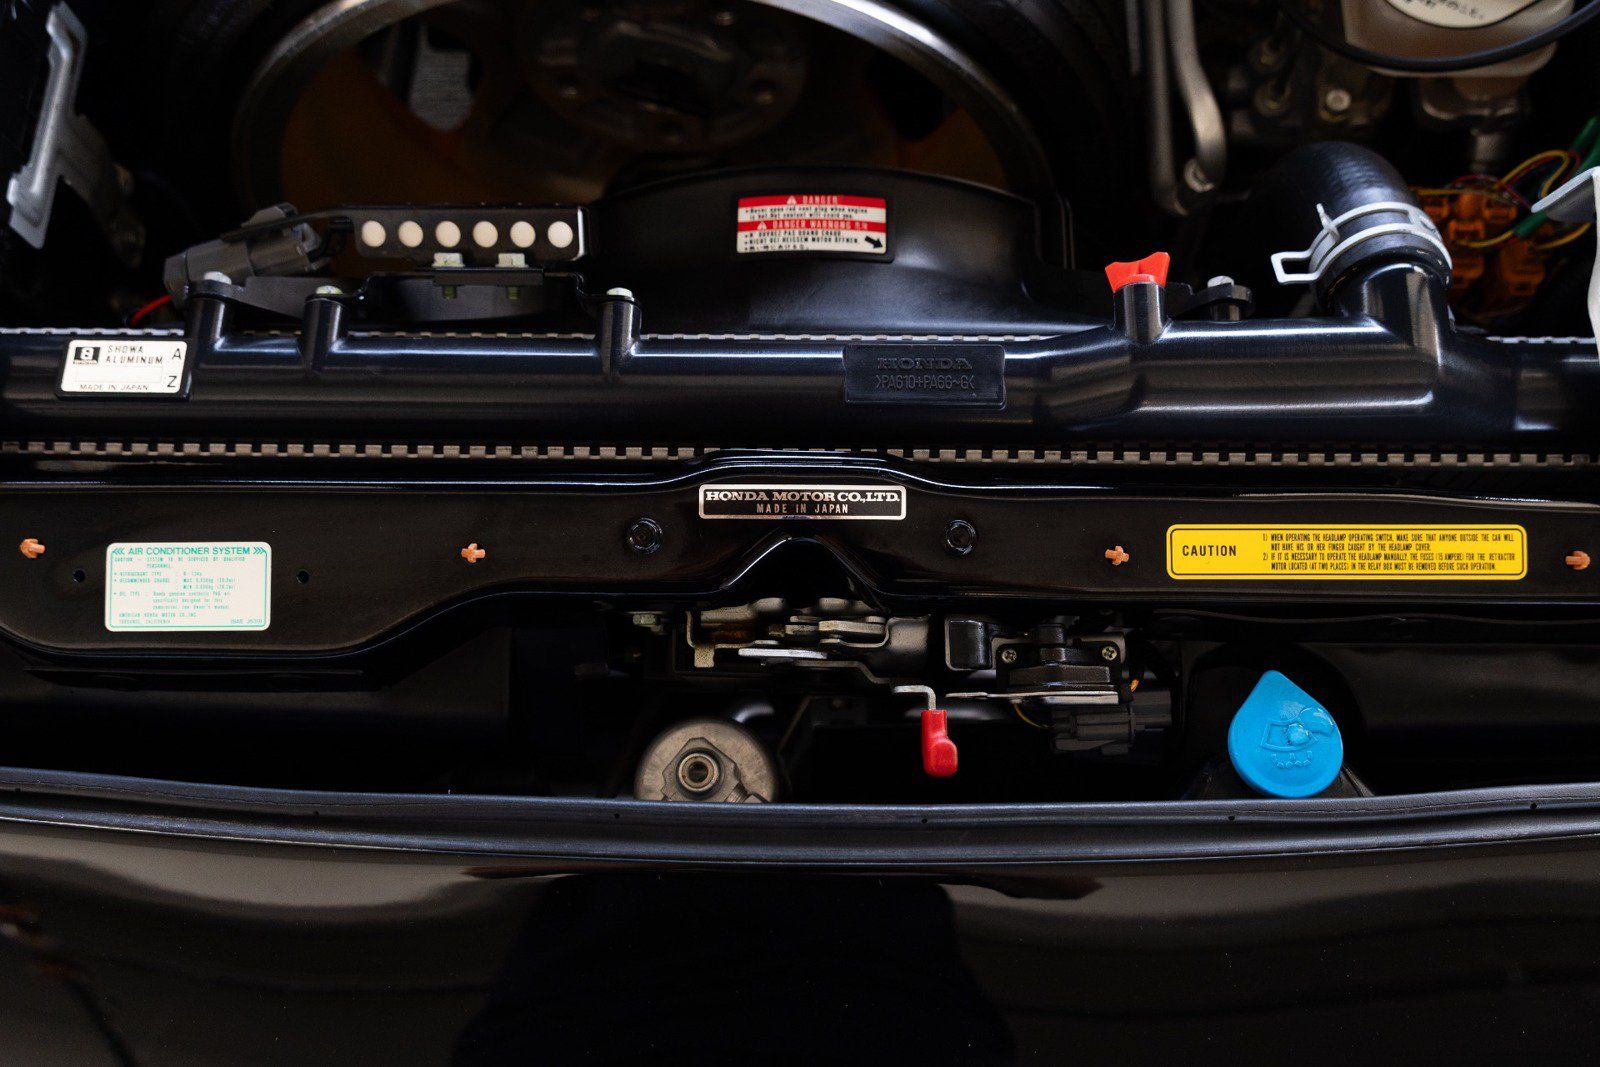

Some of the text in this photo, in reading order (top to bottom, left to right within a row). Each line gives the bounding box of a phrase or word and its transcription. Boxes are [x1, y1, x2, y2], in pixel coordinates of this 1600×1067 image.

[802, 195, 838, 204] DANGER
[108, 345, 144, 354] SHOWA
[172, 348, 181, 360] A
[106, 356, 163, 365] ALUMINUM
[877, 358, 973, 370] HONDA
[167, 376, 177, 388] Z
[706, 491, 769, 501] HONDA
[772, 491, 835, 501] MOTOR
[756, 503, 848, 514] MADE IN JAPAN
[128, 547, 250, 555] AIR CONDITIONER SYSTEM
[1182, 545, 1236, 556] CAUTION
